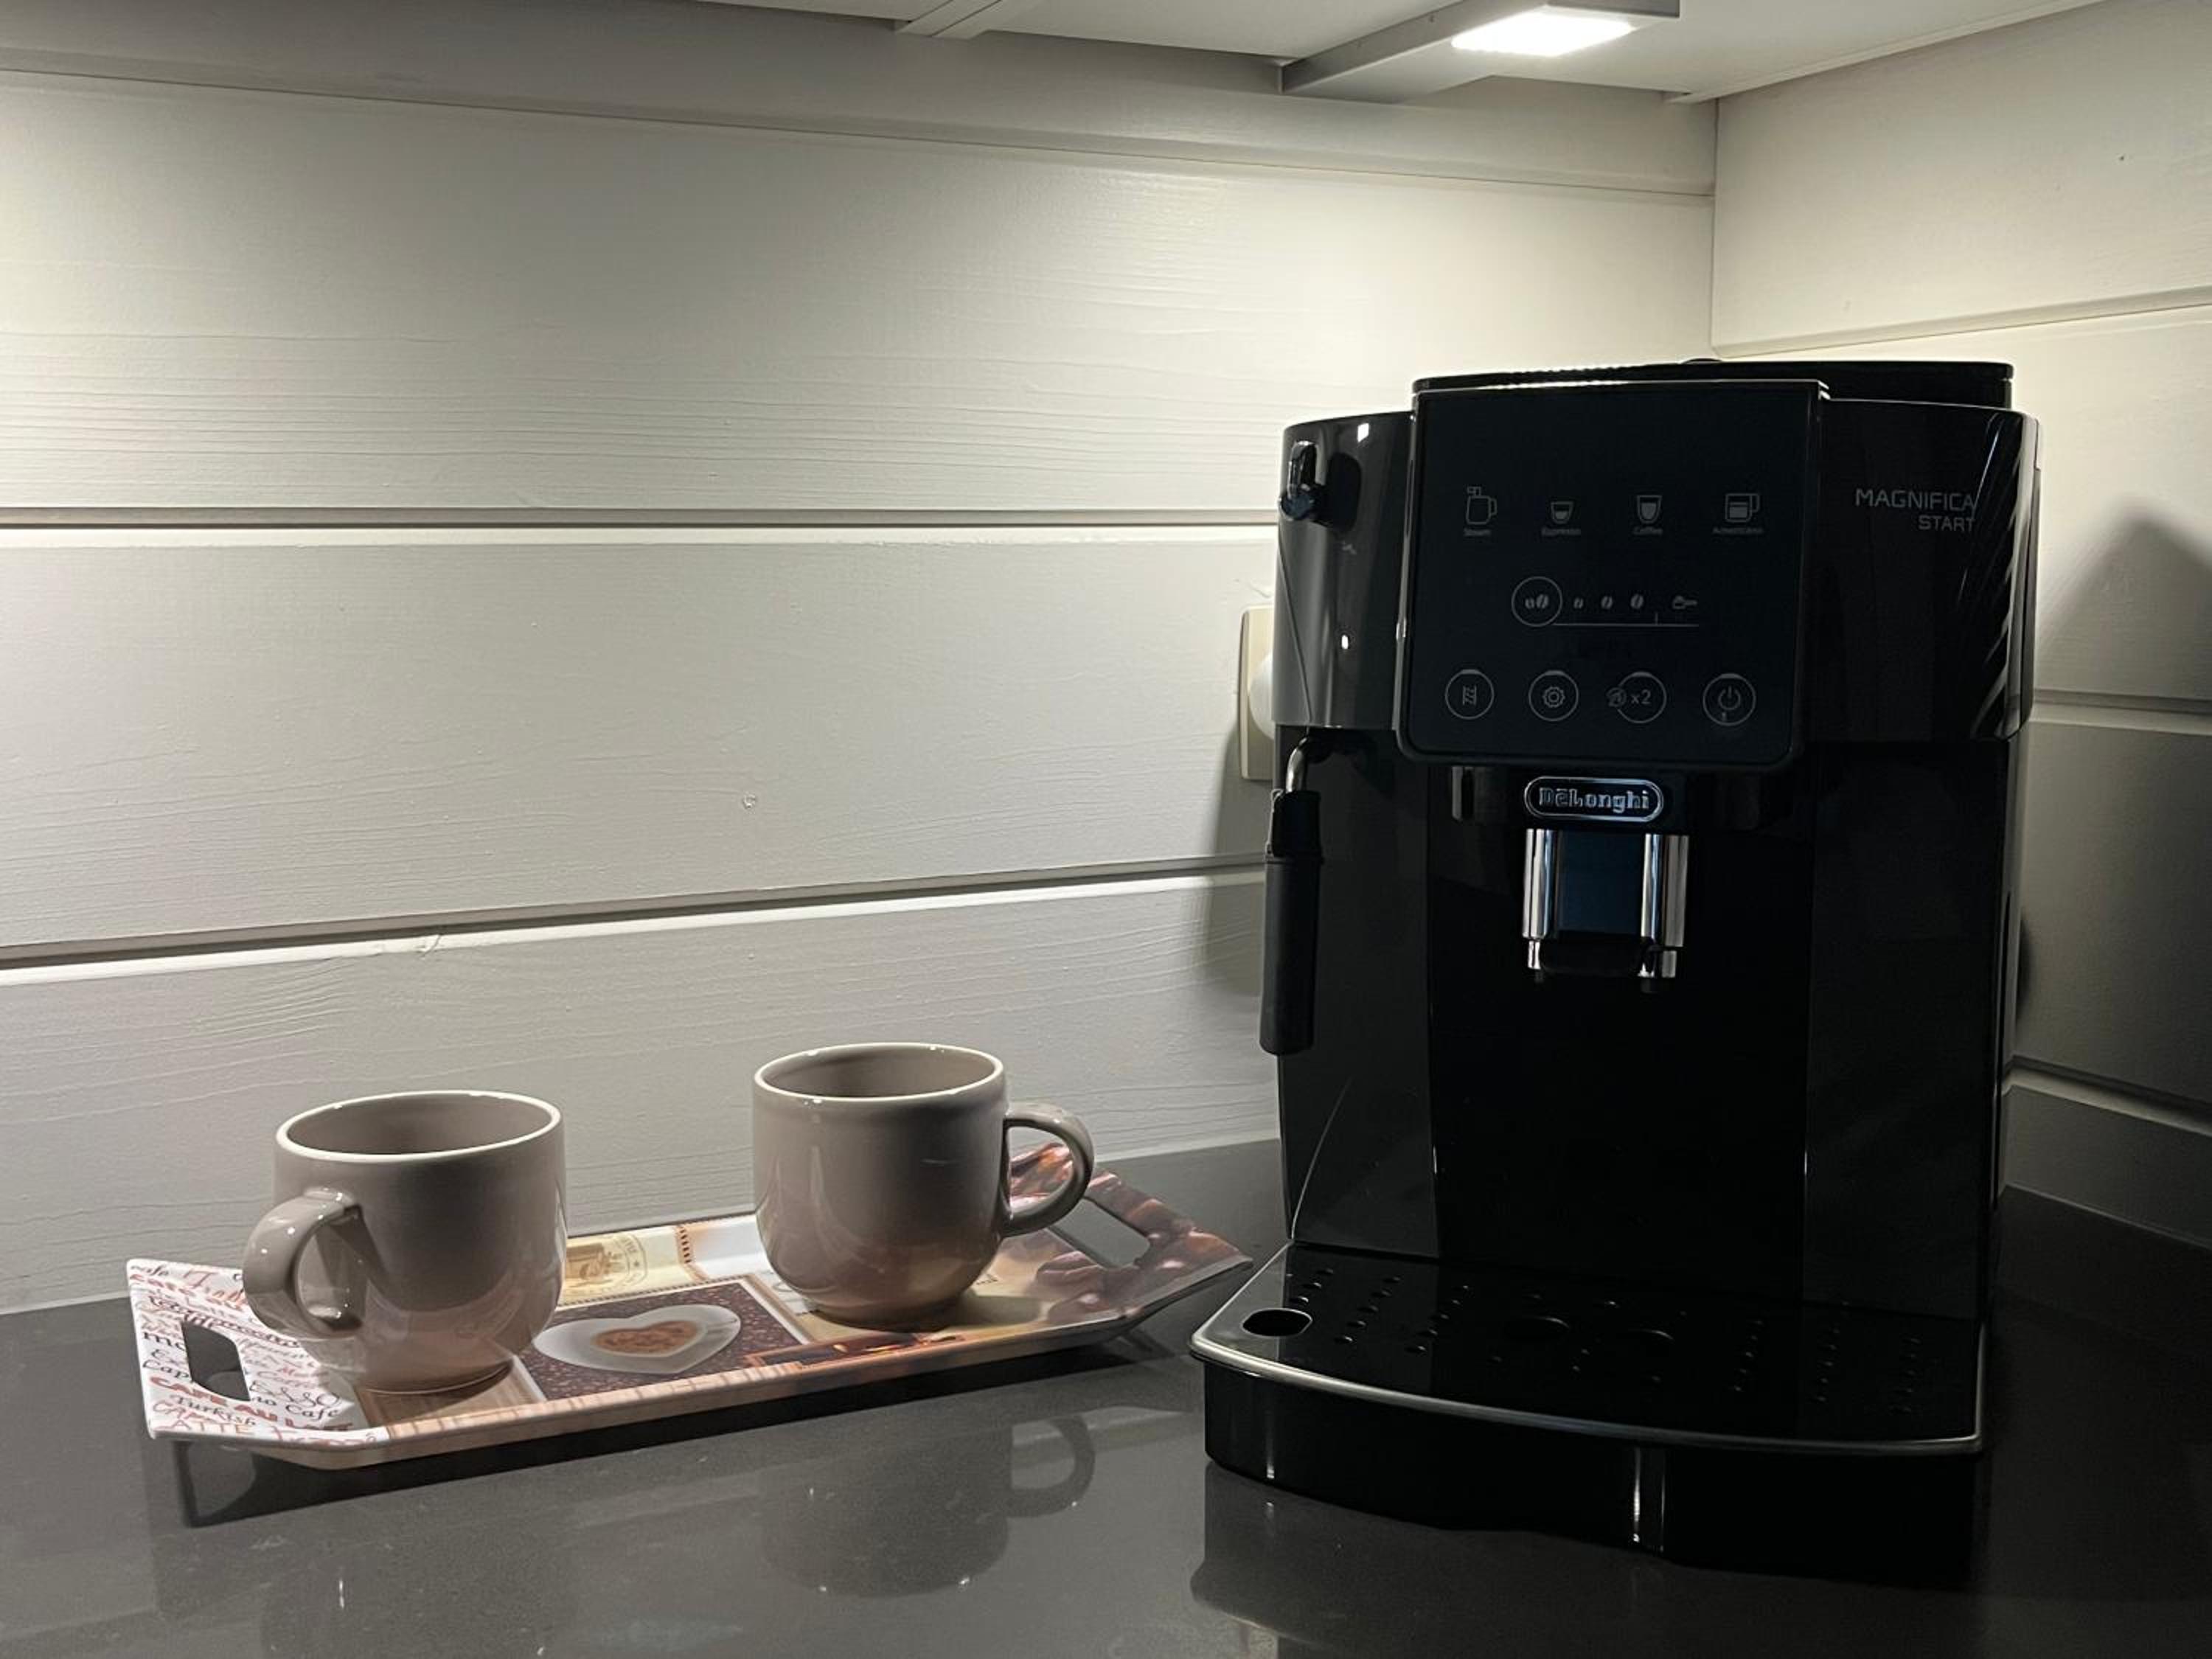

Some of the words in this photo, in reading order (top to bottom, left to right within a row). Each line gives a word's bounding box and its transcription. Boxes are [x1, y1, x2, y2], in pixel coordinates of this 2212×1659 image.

[1855, 487, 1978, 512] MAGNIFICA
[1918, 514, 1976, 532] START
[169, 1394, 257, 1427] Turkish
